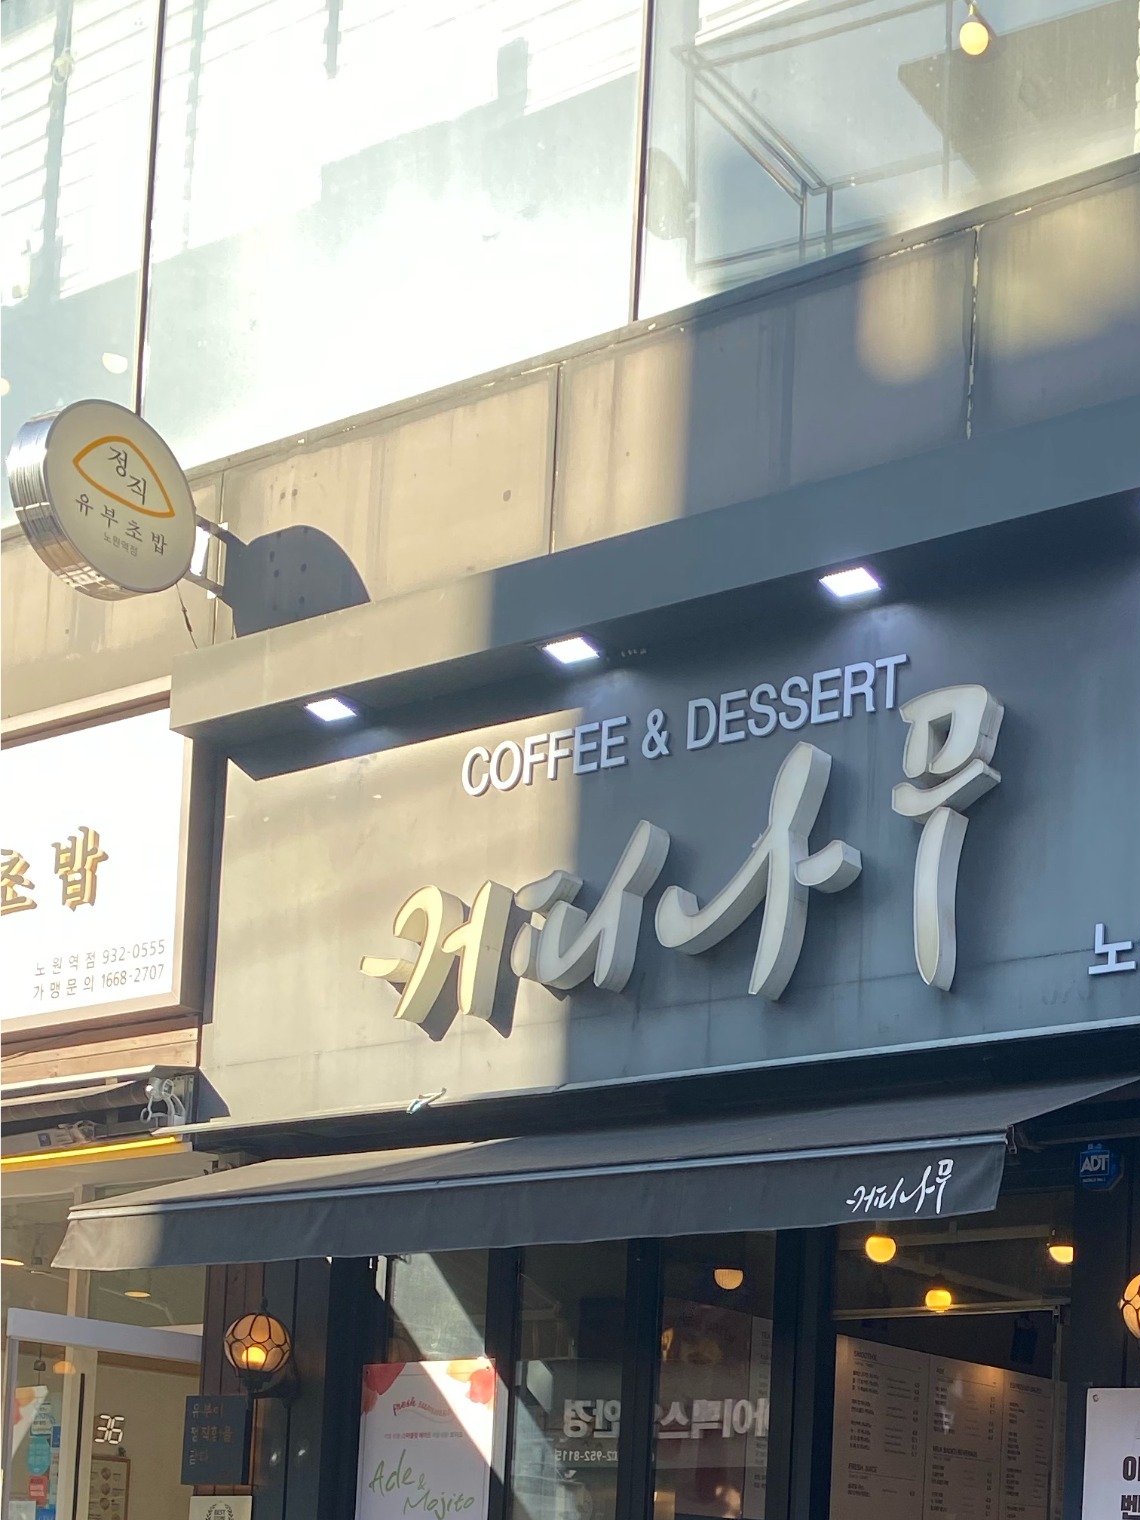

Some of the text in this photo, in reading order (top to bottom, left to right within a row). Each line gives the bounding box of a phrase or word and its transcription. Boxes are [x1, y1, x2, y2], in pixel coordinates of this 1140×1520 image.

[107, 447, 147, 505] 정직
[75, 494, 168, 556] 유부초밥
[461, 653, 909, 796] COFFEE & DESSERT
[360, 684, 1004, 1023] 커피나무
[34, 939, 165, 977] 노원역점 932-0555
[33, 964, 164, 1000] 가맹문의 1668-2707
[846, 1159, 954, 1214] 커피나무
[1080, 1155, 1109, 1172] ADT
[94, 1414, 125, 1444] 36
[369, 1449, 415, 1496] Ade
[403, 1489, 475, 1520] Mojito
